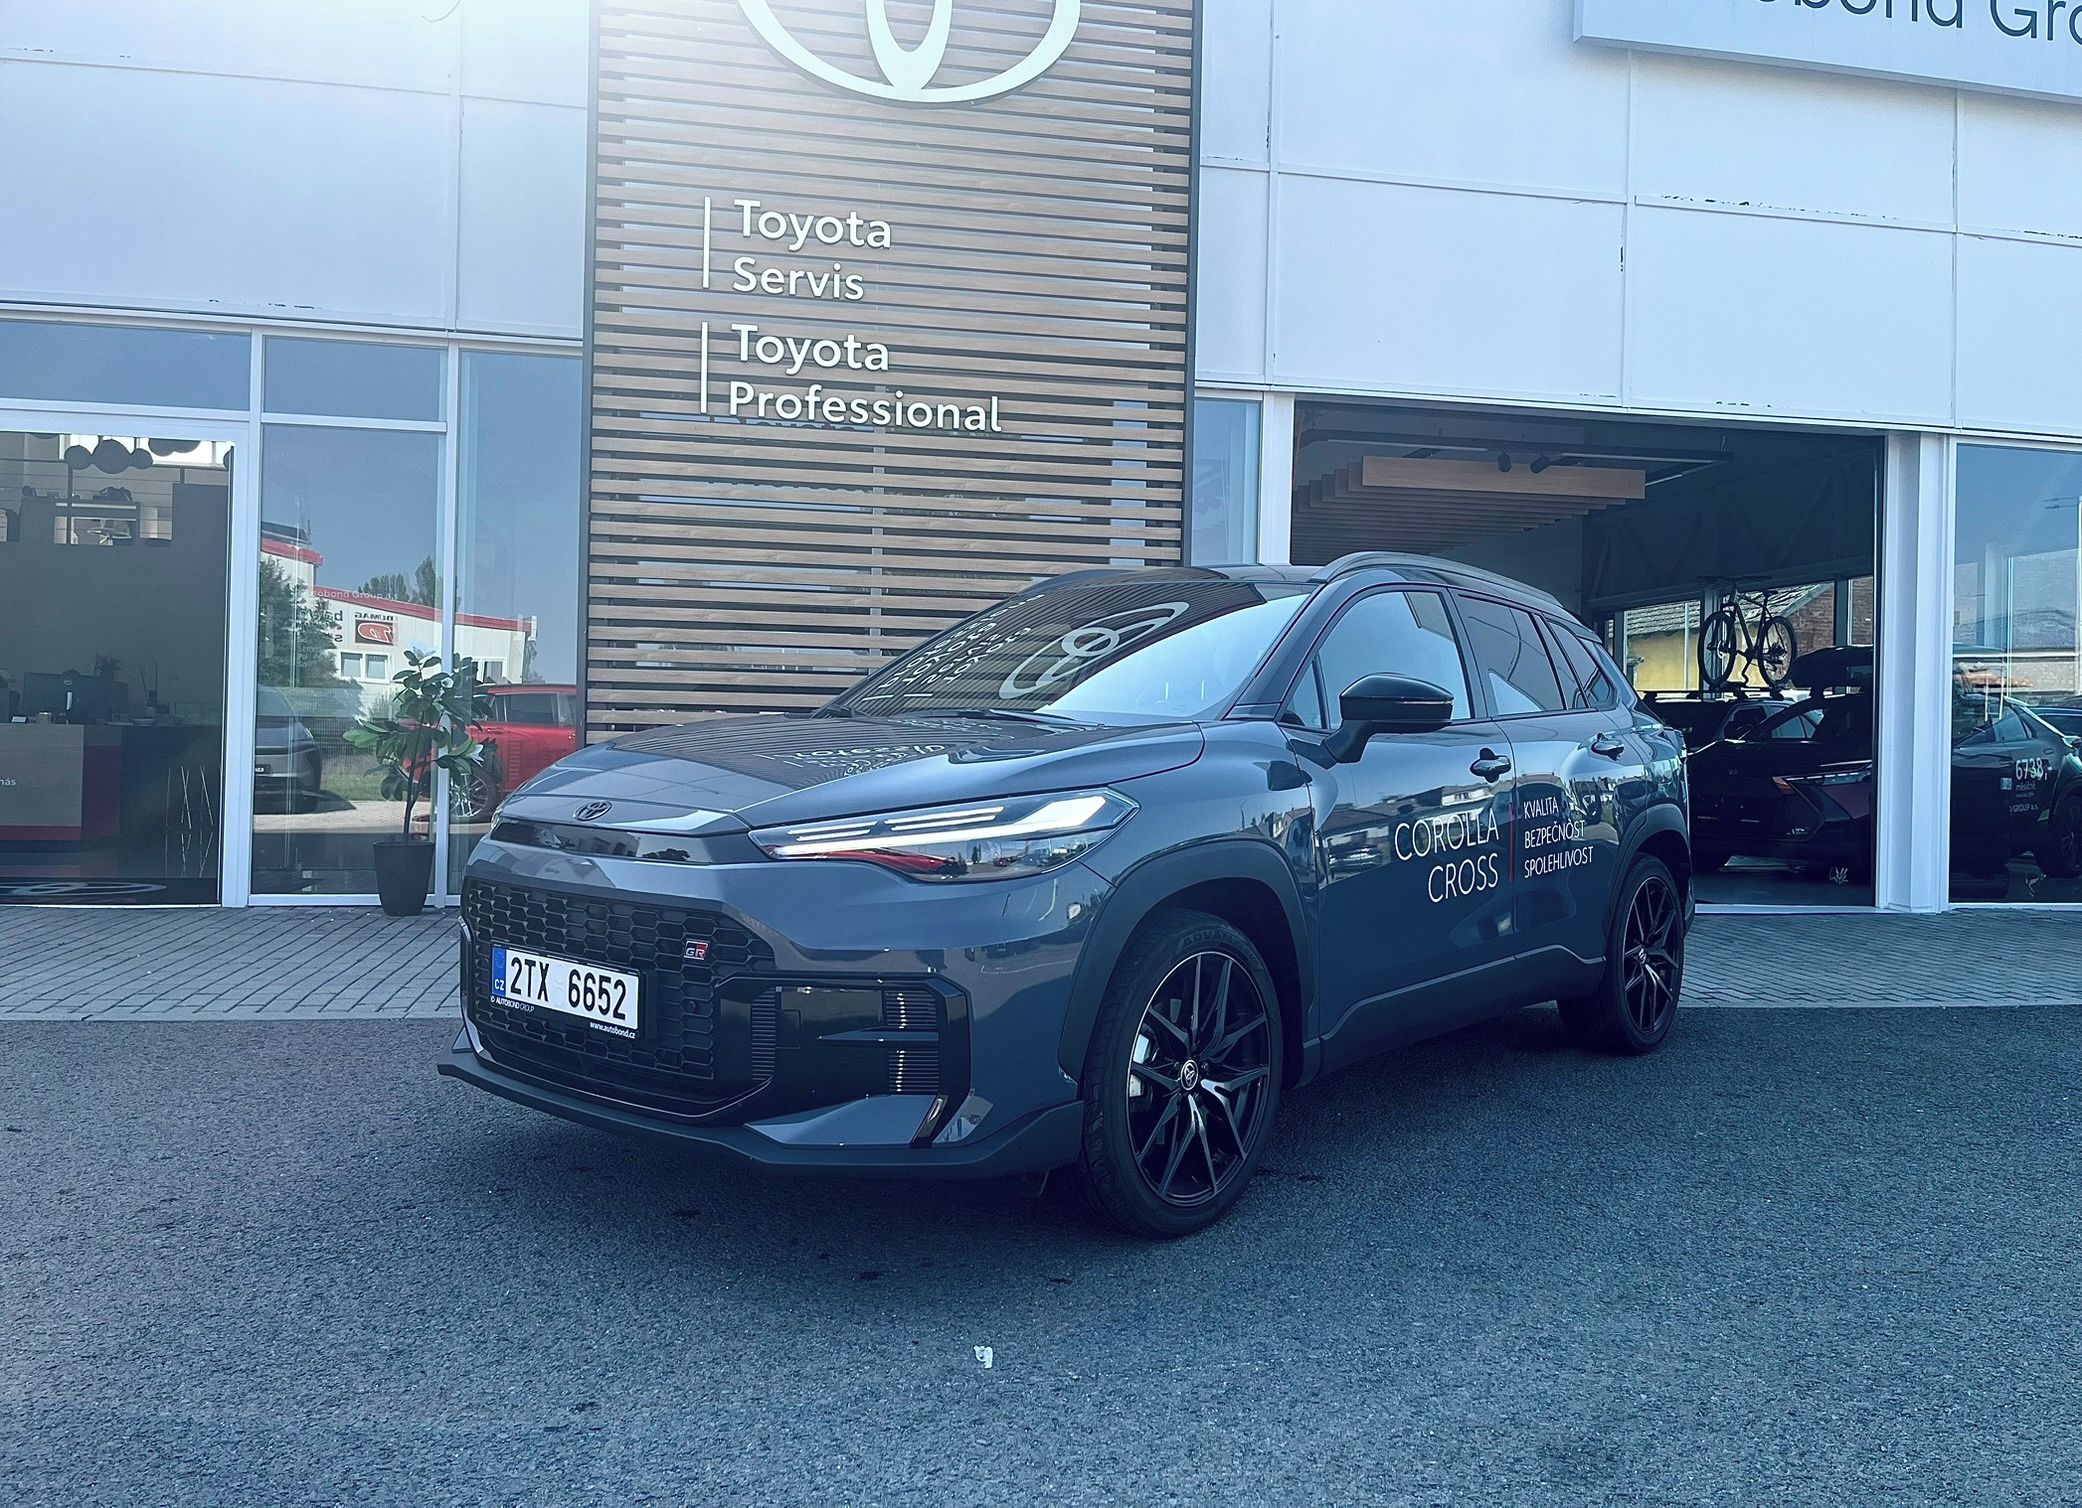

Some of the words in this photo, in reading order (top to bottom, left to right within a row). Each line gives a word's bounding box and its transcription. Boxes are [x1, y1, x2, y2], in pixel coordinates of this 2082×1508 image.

[733, 199, 892, 252] Toyota
[732, 256, 864, 300] Servis
[731, 323, 889, 375] Toyota
[729, 381, 1002, 432] Professional
[1523, 797, 1559, 819] KVALITA
[1394, 808, 1499, 861] COROLLA
[1523, 818, 1586, 849] BEZPEČNOST
[1428, 853, 1499, 903] CROSS
[1523, 846, 1594, 878] SPOLEHLIVOST
[685, 946, 706, 959] GR
[494, 978, 505, 991] CZ
[510, 957, 550, 1002] 2TX
[568, 969, 626, 1021] 6652
[495, 996, 520, 1011] AUTOBOND
[519, 1002, 535, 1013] GROUP
[589, 1021, 636, 1039] www.autobond.cz
